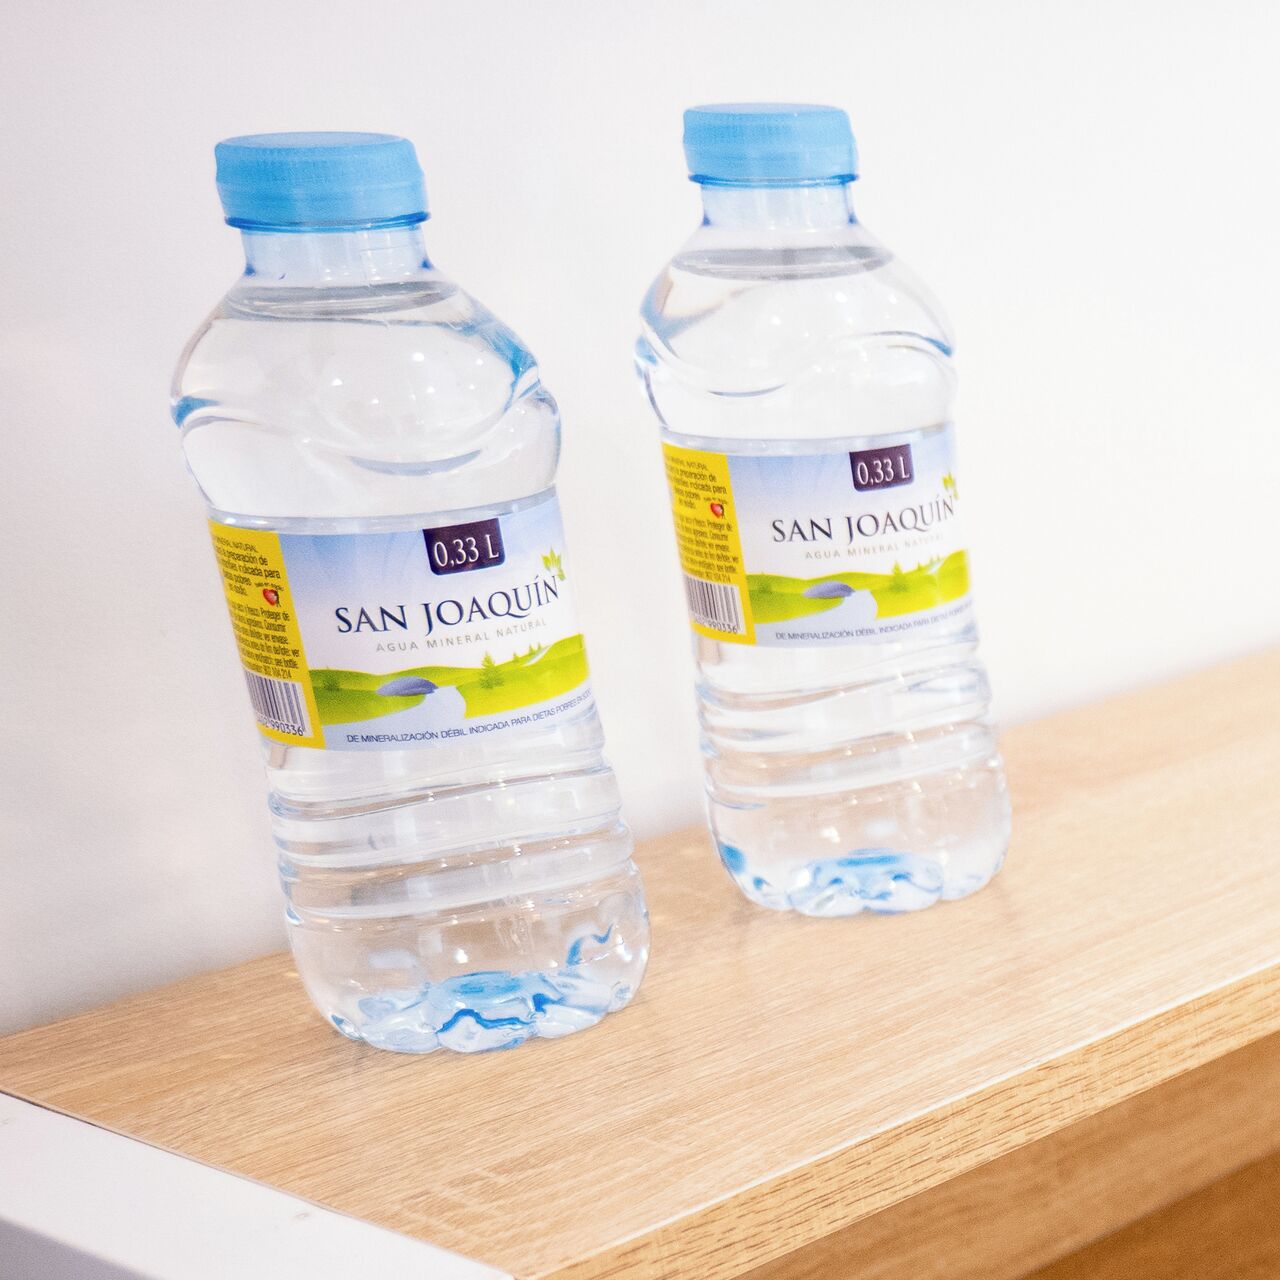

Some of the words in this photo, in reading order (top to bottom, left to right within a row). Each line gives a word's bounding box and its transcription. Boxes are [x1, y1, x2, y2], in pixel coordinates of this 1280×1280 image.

[857, 460, 894, 485] 0,33
[900, 456, 909, 478] L
[713, 485, 727, 494] para
[772, 517, 832, 543] SAN
[845, 495, 955, 545] JOAQUÍN
[259, 555, 268, 566] de
[434, 537, 479, 568] 0,33
[486, 534, 499, 559] L
[805, 550, 841, 560] AGUA
[847, 543, 899, 557] MINERAL
[264, 568, 281, 579] para
[335, 604, 408, 634] SAN
[420, 574, 559, 636] JOAQUÍN
[376, 641, 419, 653] AGUA
[427, 631, 490, 649] MINERAL
[496, 618, 547, 637] NATURAL
[775, 632, 787, 640] DE
[787, 629, 855, 641] MINERALIZACIÓN
[347, 733, 360, 743] DE
[361, 728, 439, 743] MINERALIZACIÓN
[441, 726, 466, 738] DÉBIL
[469, 719, 510, 735] INDICADA
[511, 715, 532, 727] PARA
[532, 707, 556, 721] DIETAS
